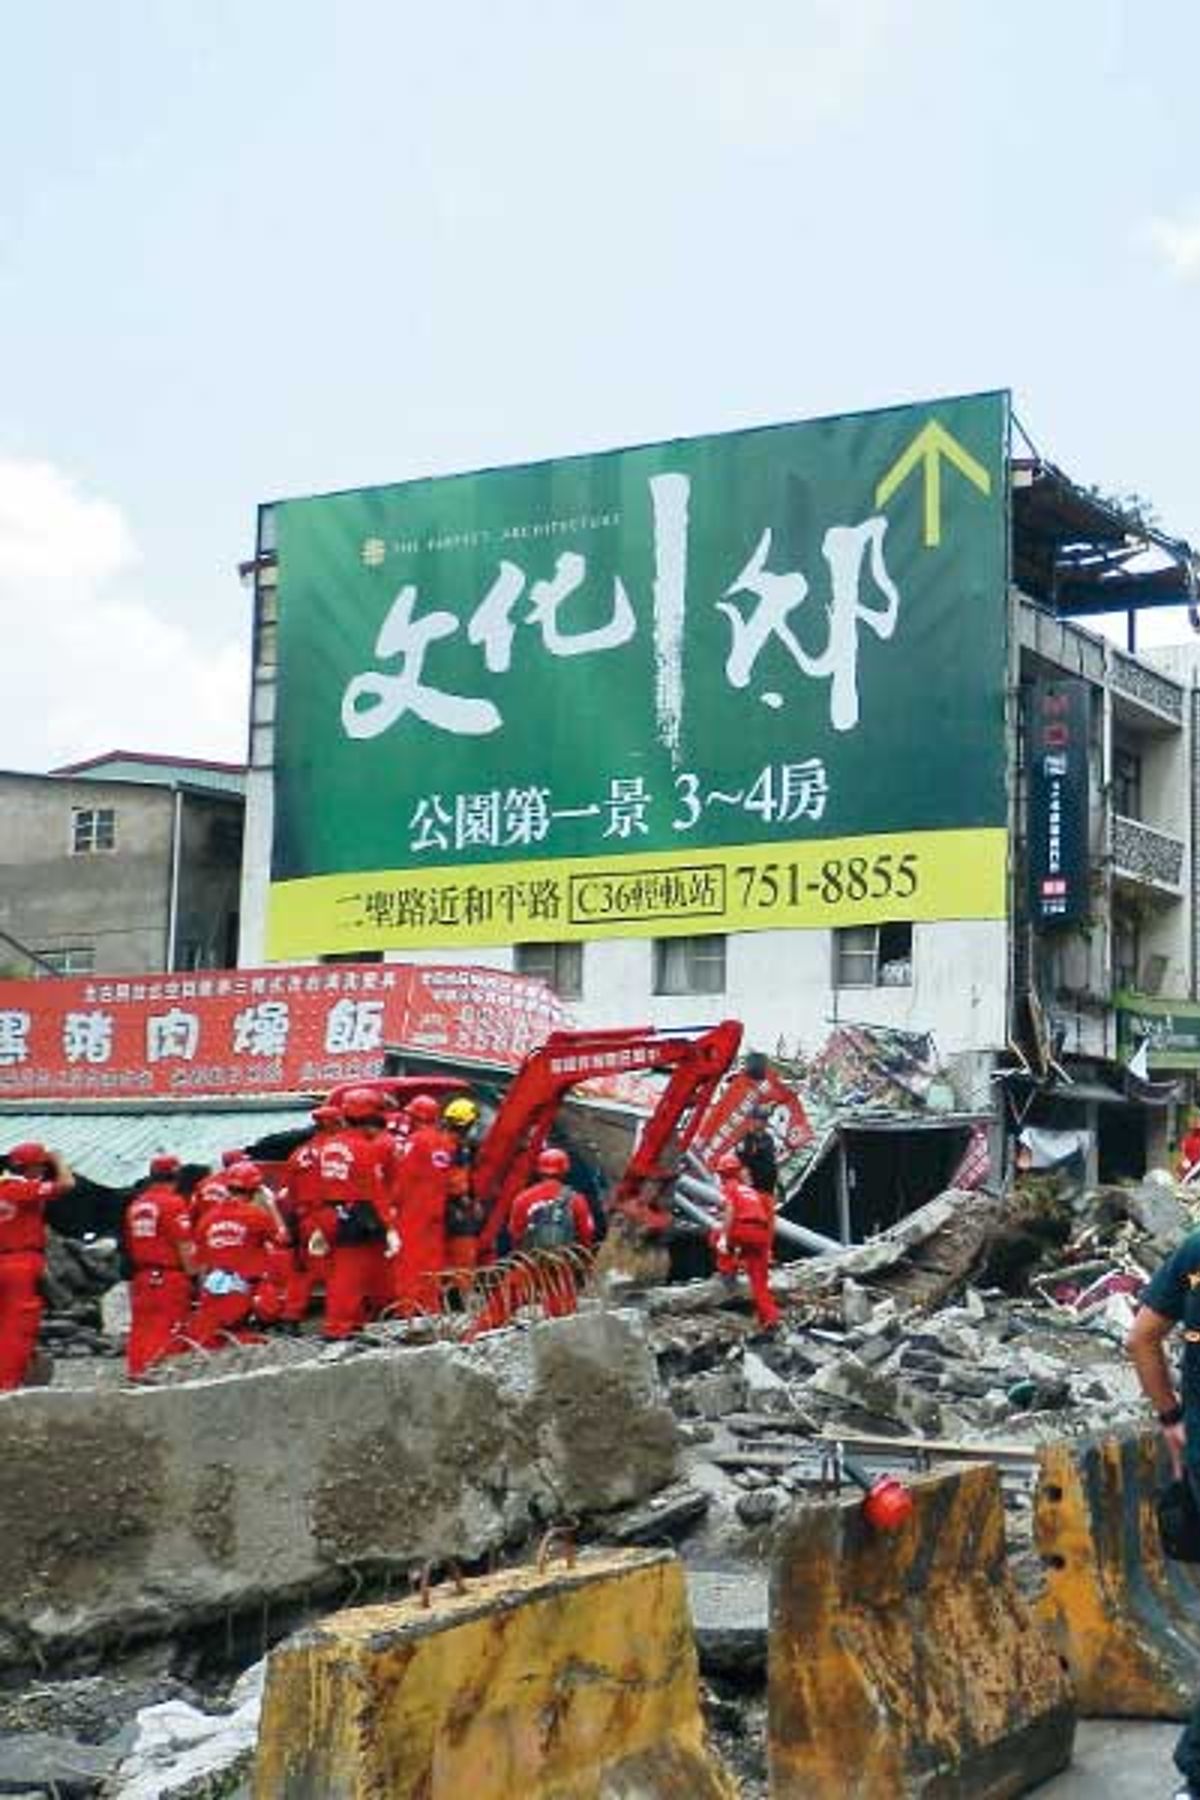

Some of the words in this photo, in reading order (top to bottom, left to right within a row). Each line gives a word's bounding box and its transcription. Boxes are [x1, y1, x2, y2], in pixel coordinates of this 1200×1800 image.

[341, 551, 636, 740] 文化
[408, 777, 650, 852] 公園第一景
[737, 854, 920, 911] 751-8855
